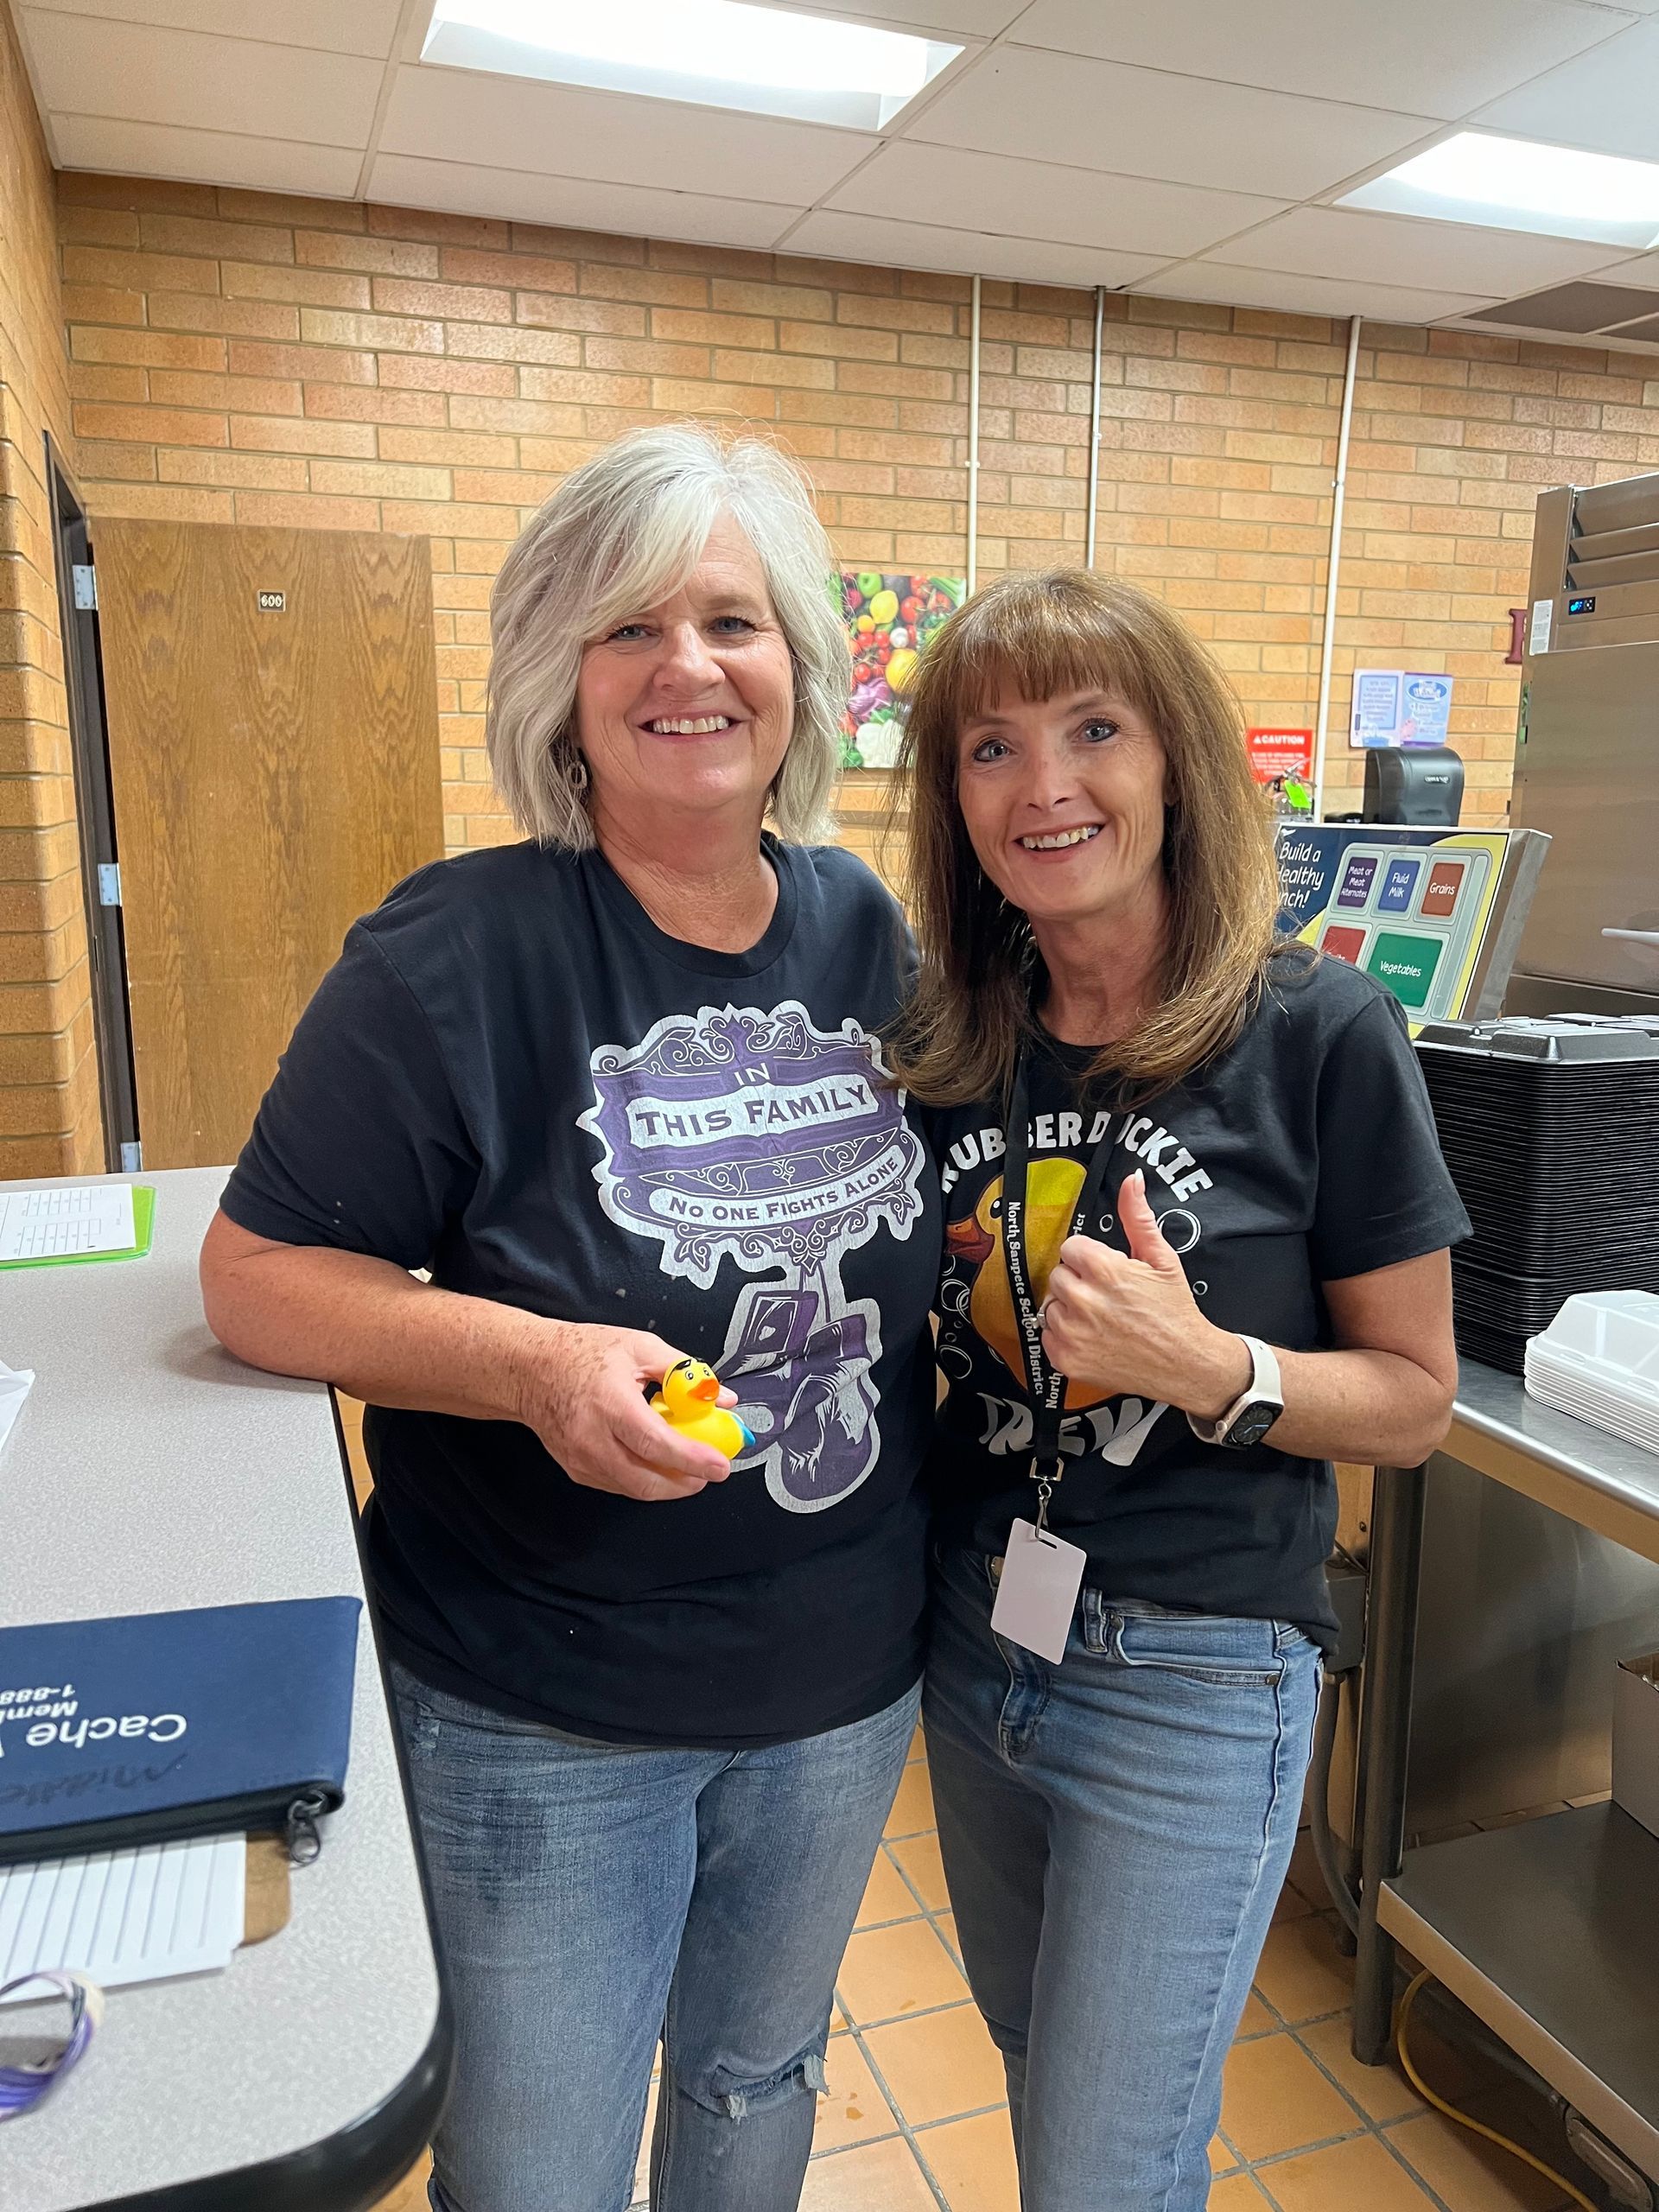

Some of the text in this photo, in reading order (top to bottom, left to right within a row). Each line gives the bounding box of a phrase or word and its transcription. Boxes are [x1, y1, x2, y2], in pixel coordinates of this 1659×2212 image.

[261, 594, 283, 607] 600
[1261, 734, 1306, 745] CAUTION
[1279, 842, 1322, 862] Build a
[1348, 866, 1365, 876] Meat
[1391, 873, 1410, 884] Fluid
[1349, 877, 1365, 887] Meat
[1429, 882, 1456, 896] Grains
[1340, 887, 1368, 898] Alternates
[1389, 887, 1405, 898] Milk
[1380, 960, 1422, 977] Vegetables
[734, 1062, 772, 1086] IN
[636, 1084, 868, 1137] THIS FAMILY
[712, 1205, 760, 1220] ONE
[766, 1191, 839, 1218] FIGHTS
[845, 1157, 899, 1198] ALONE
[1007, 1202, 1021, 1242] North
[1009, 1241, 1026, 1295] Sanpete
[1020, 1298, 1039, 1342] School
[1046, 1372, 1065, 1409] North
[26, 1713, 188, 1749] Cache
